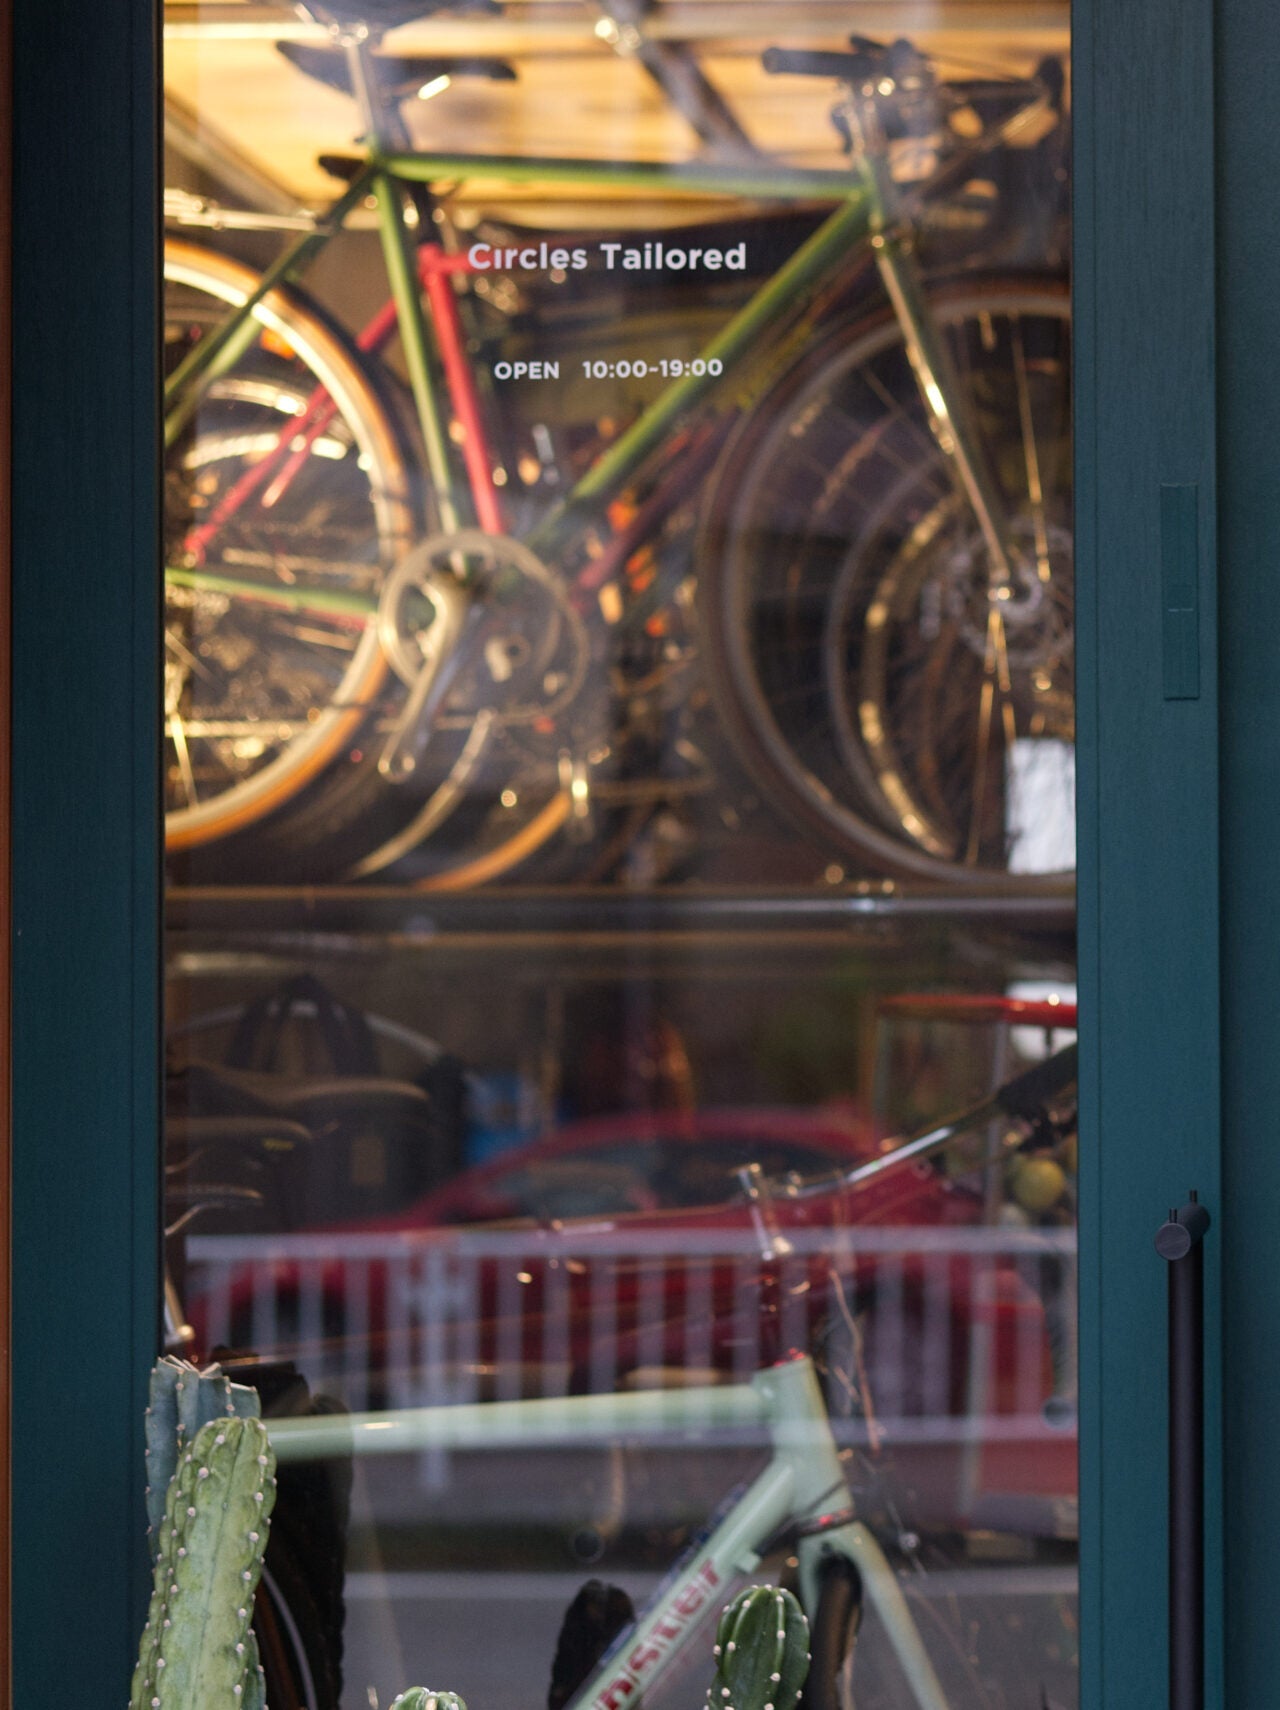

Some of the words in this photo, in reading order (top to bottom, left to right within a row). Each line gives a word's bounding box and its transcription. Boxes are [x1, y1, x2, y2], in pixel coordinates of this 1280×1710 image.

[468, 243, 588, 269] Circles
[600, 243, 746, 269] Tailored
[494, 361, 559, 379] OPEN
